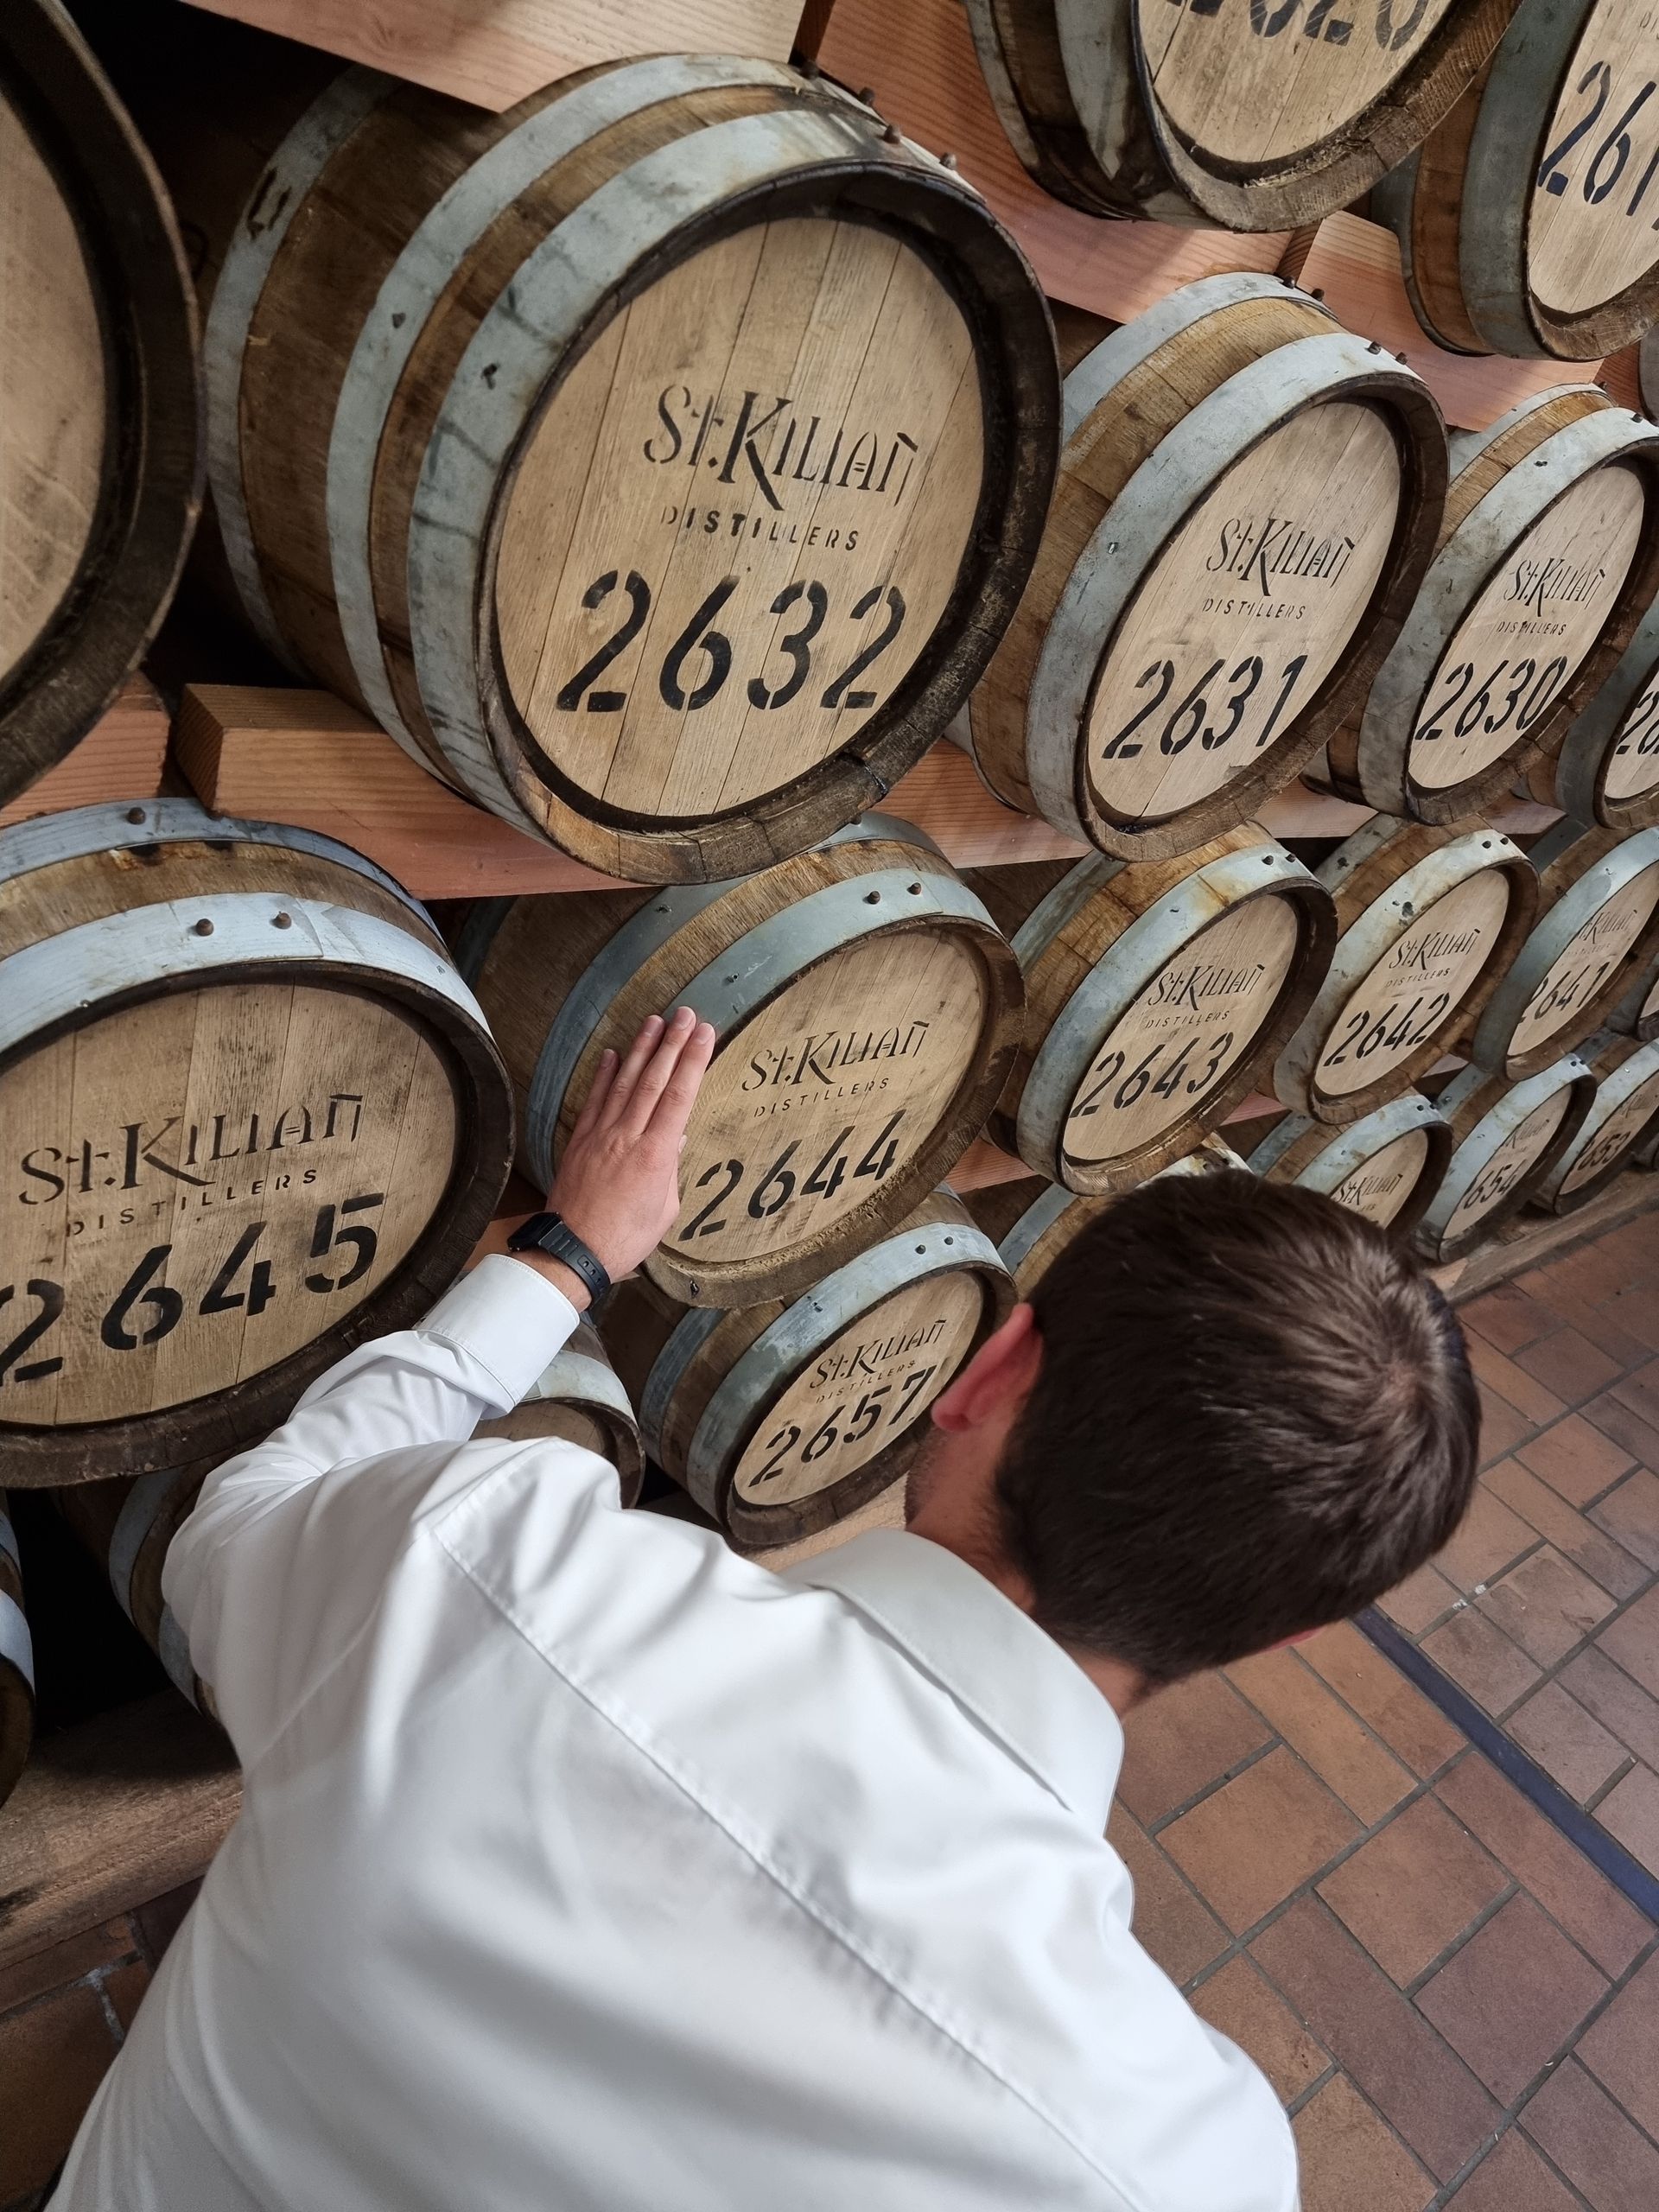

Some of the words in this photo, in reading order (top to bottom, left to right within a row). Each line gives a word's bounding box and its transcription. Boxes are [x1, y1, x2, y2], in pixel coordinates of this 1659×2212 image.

[1538, 60, 1659, 232] 261
[660, 505, 859, 551] DISTILLERS
[556, 569, 906, 713] 2632
[1202, 597, 1306, 620] DISTILLERS
[1496, 620, 1567, 636] DISTILLERS
[1102, 654, 1308, 760] 2631
[1414, 655, 1567, 741] 2630
[1383, 968, 1451, 988] DISTILLERS
[1144, 1009, 1230, 1029] DISTILLERS
[1323, 992, 1450, 1066] 2642
[753, 1077, 889, 1118] DISTILLERS
[1069, 1032, 1234, 1118] 2643
[66, 1169, 317, 1237] DISTILLERS
[677, 1109, 906, 1242] 2644
[1463, 1159, 1528, 1210] 654
[0, 1192, 385, 1382] 2645
[815, 1360, 917, 1404] DISTILLERS
[748, 1364, 938, 1488] 2657
